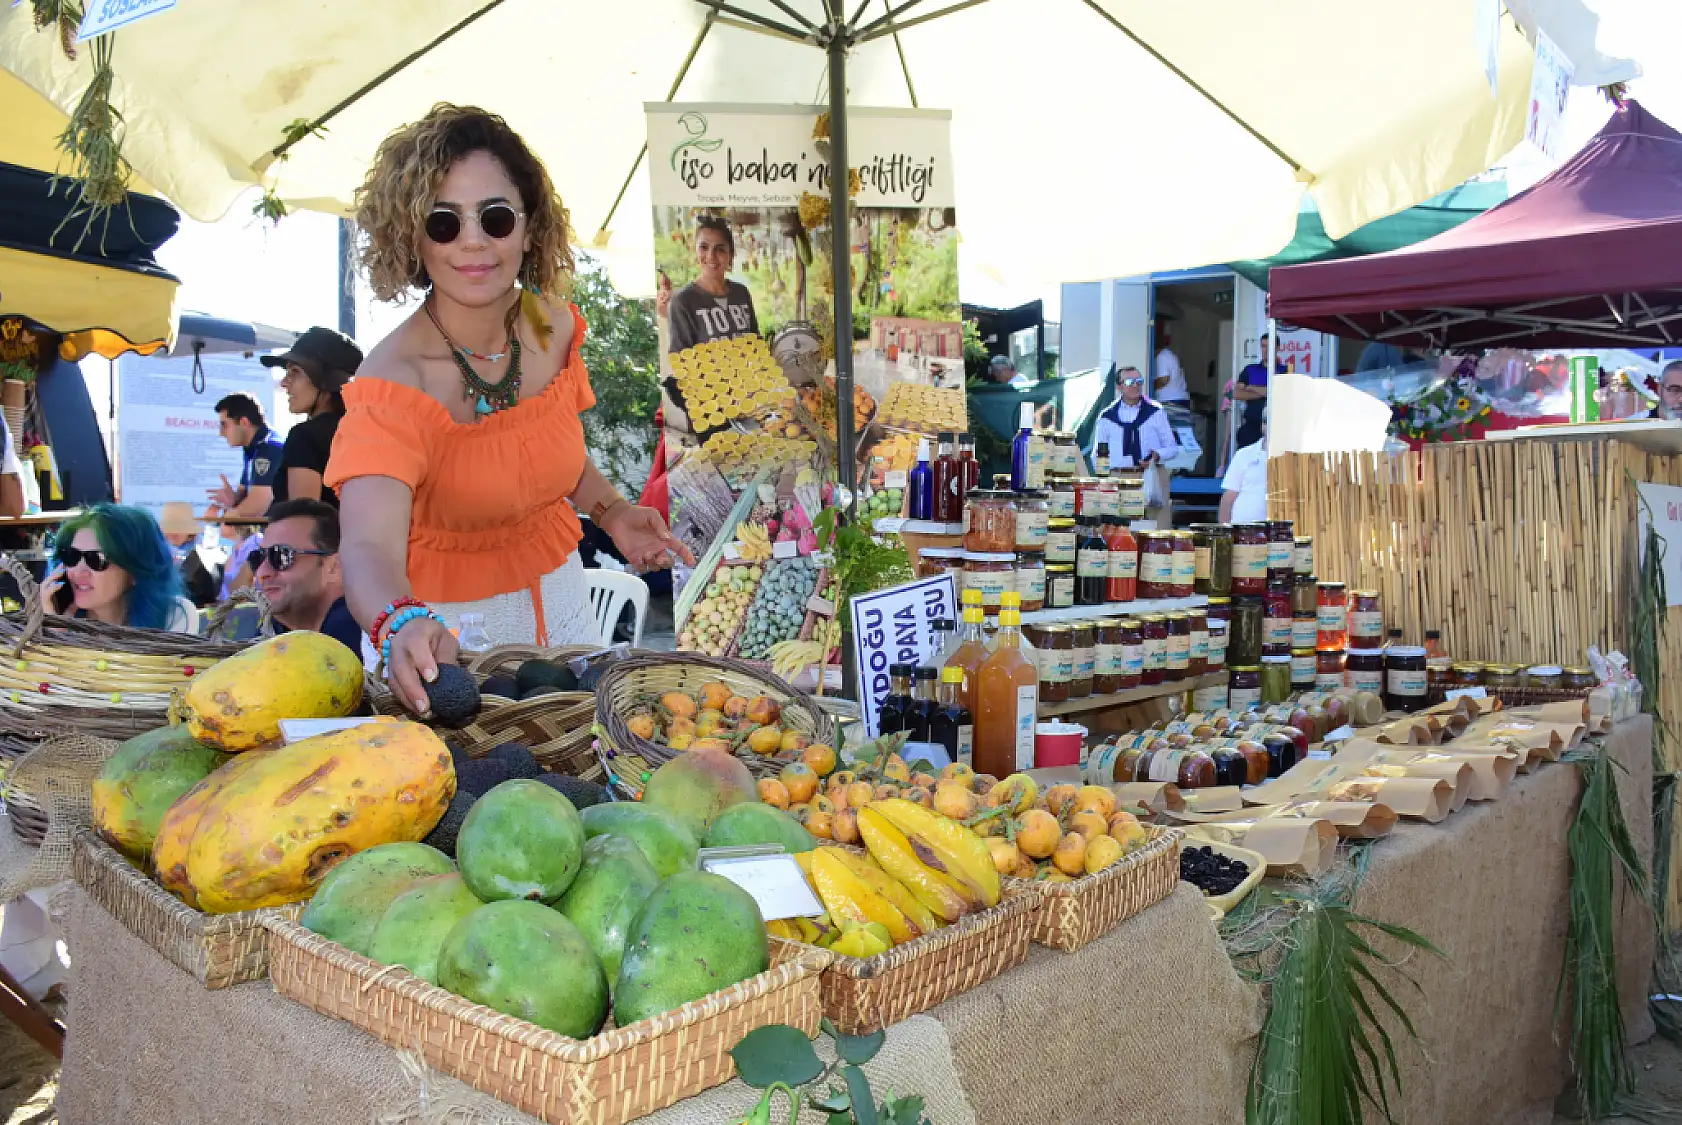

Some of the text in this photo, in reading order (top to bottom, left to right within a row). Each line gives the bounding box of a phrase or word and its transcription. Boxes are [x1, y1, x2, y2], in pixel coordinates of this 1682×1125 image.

[696, 307, 730, 336] TO
[1279, 340, 1311, 353] UĞLA
[165, 417, 200, 428] BEACH
